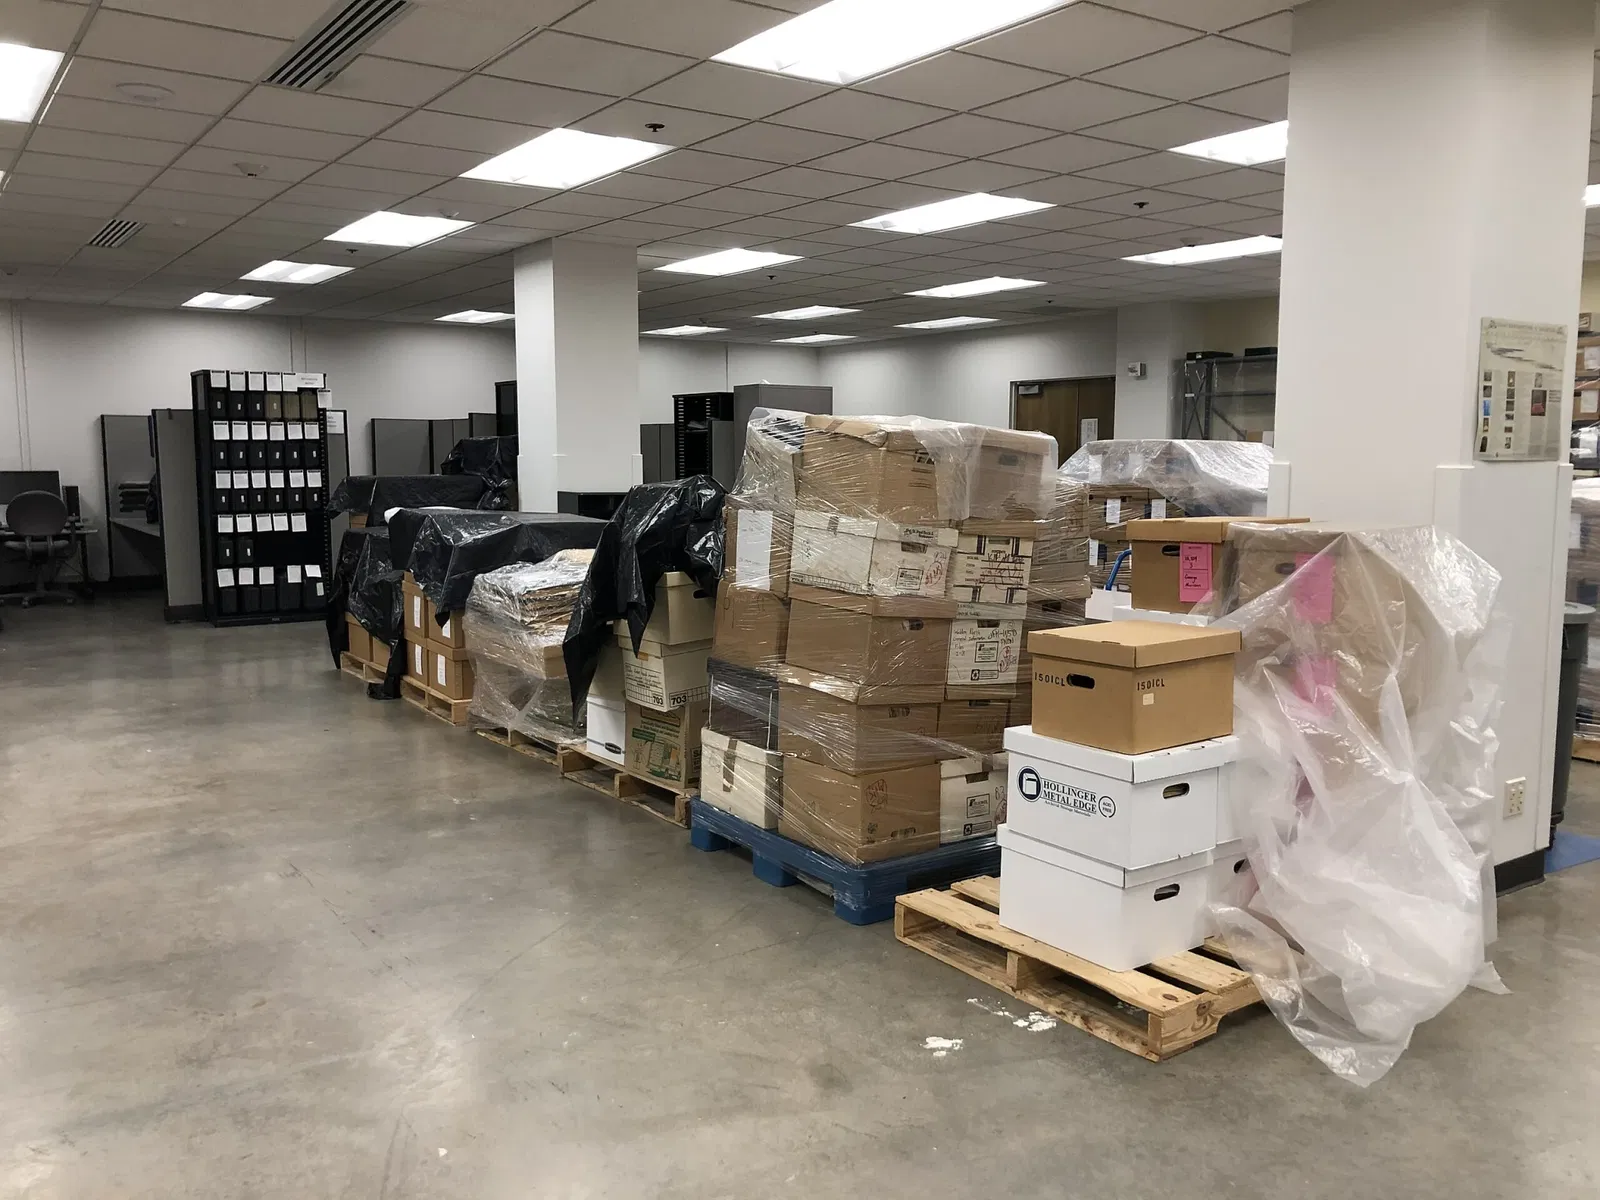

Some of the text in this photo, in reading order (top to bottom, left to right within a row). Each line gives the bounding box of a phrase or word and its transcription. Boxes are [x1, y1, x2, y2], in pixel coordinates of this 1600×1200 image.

[652, 695, 664, 705] 703
[671, 695, 687, 705] 703
[1043, 780, 1097, 803] HOLLINGER
[1043, 789, 1097, 813] METAL EDGE
